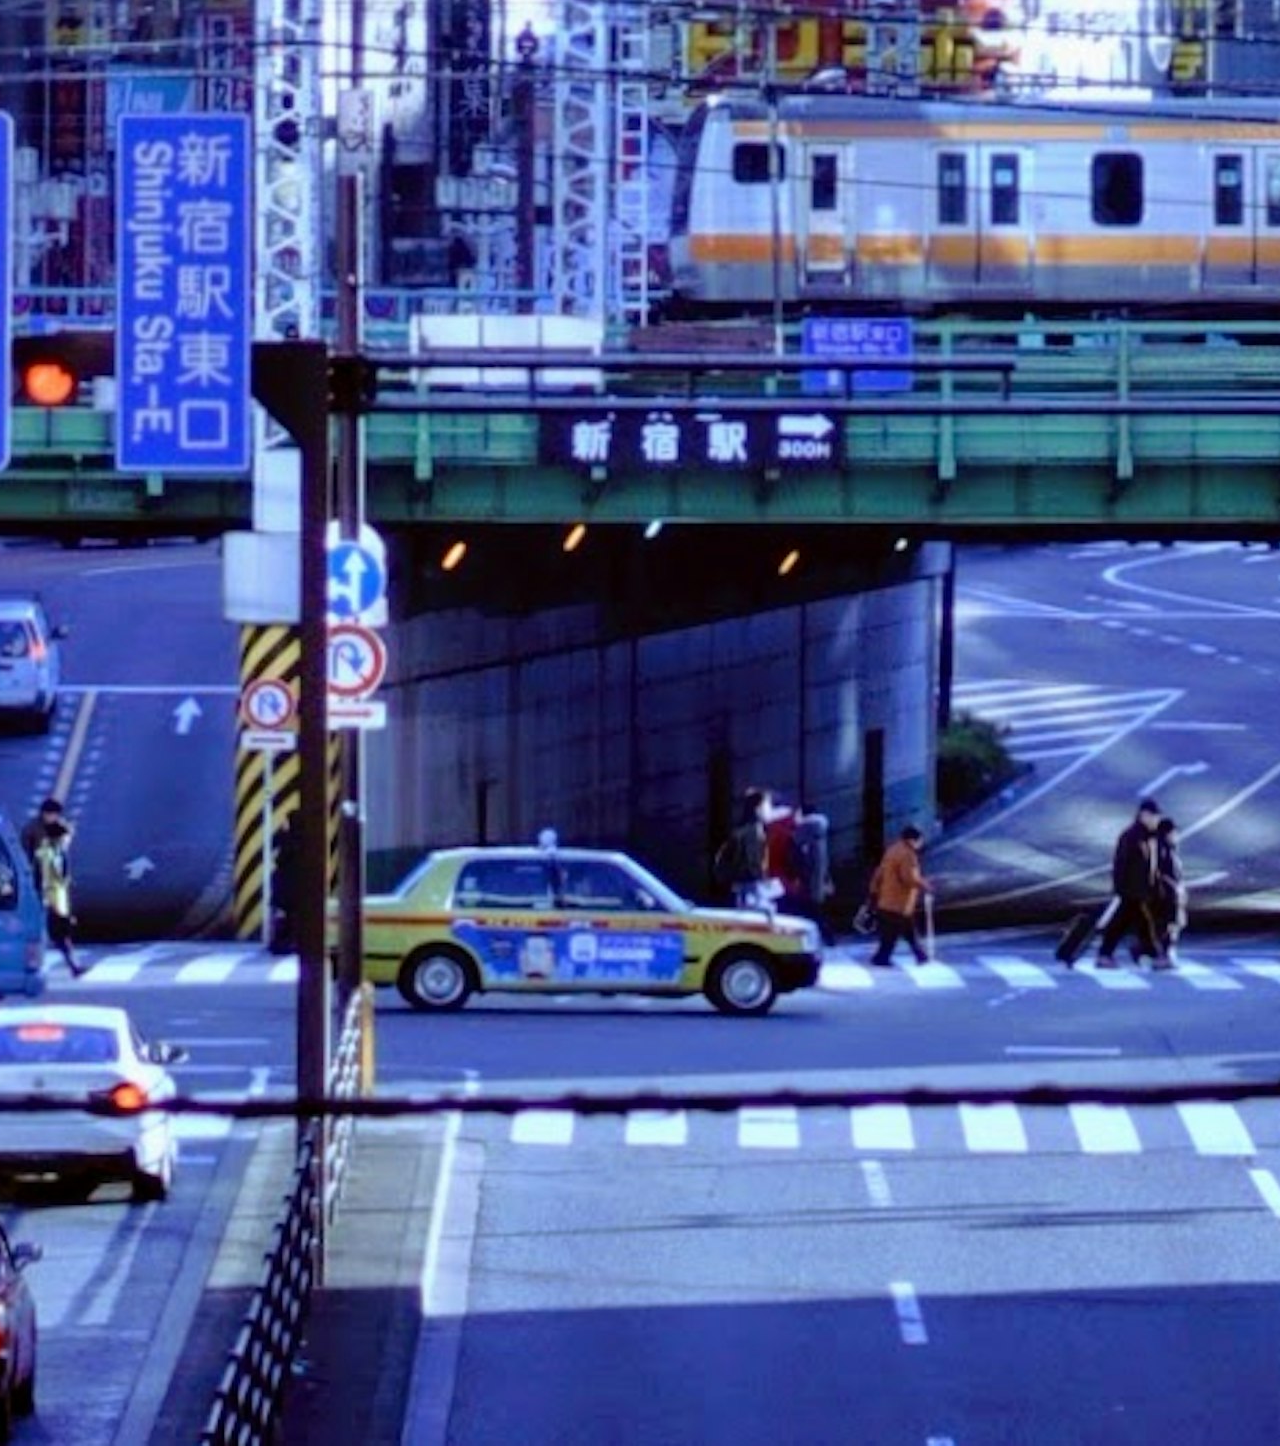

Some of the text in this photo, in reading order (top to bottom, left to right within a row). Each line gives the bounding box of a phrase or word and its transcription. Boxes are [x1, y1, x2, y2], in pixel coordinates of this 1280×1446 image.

[133, 142, 173, 300] Shinjuku
[175, 131, 233, 451] 新宿駅東口
[572, 420, 748, 461] 新宿駅
